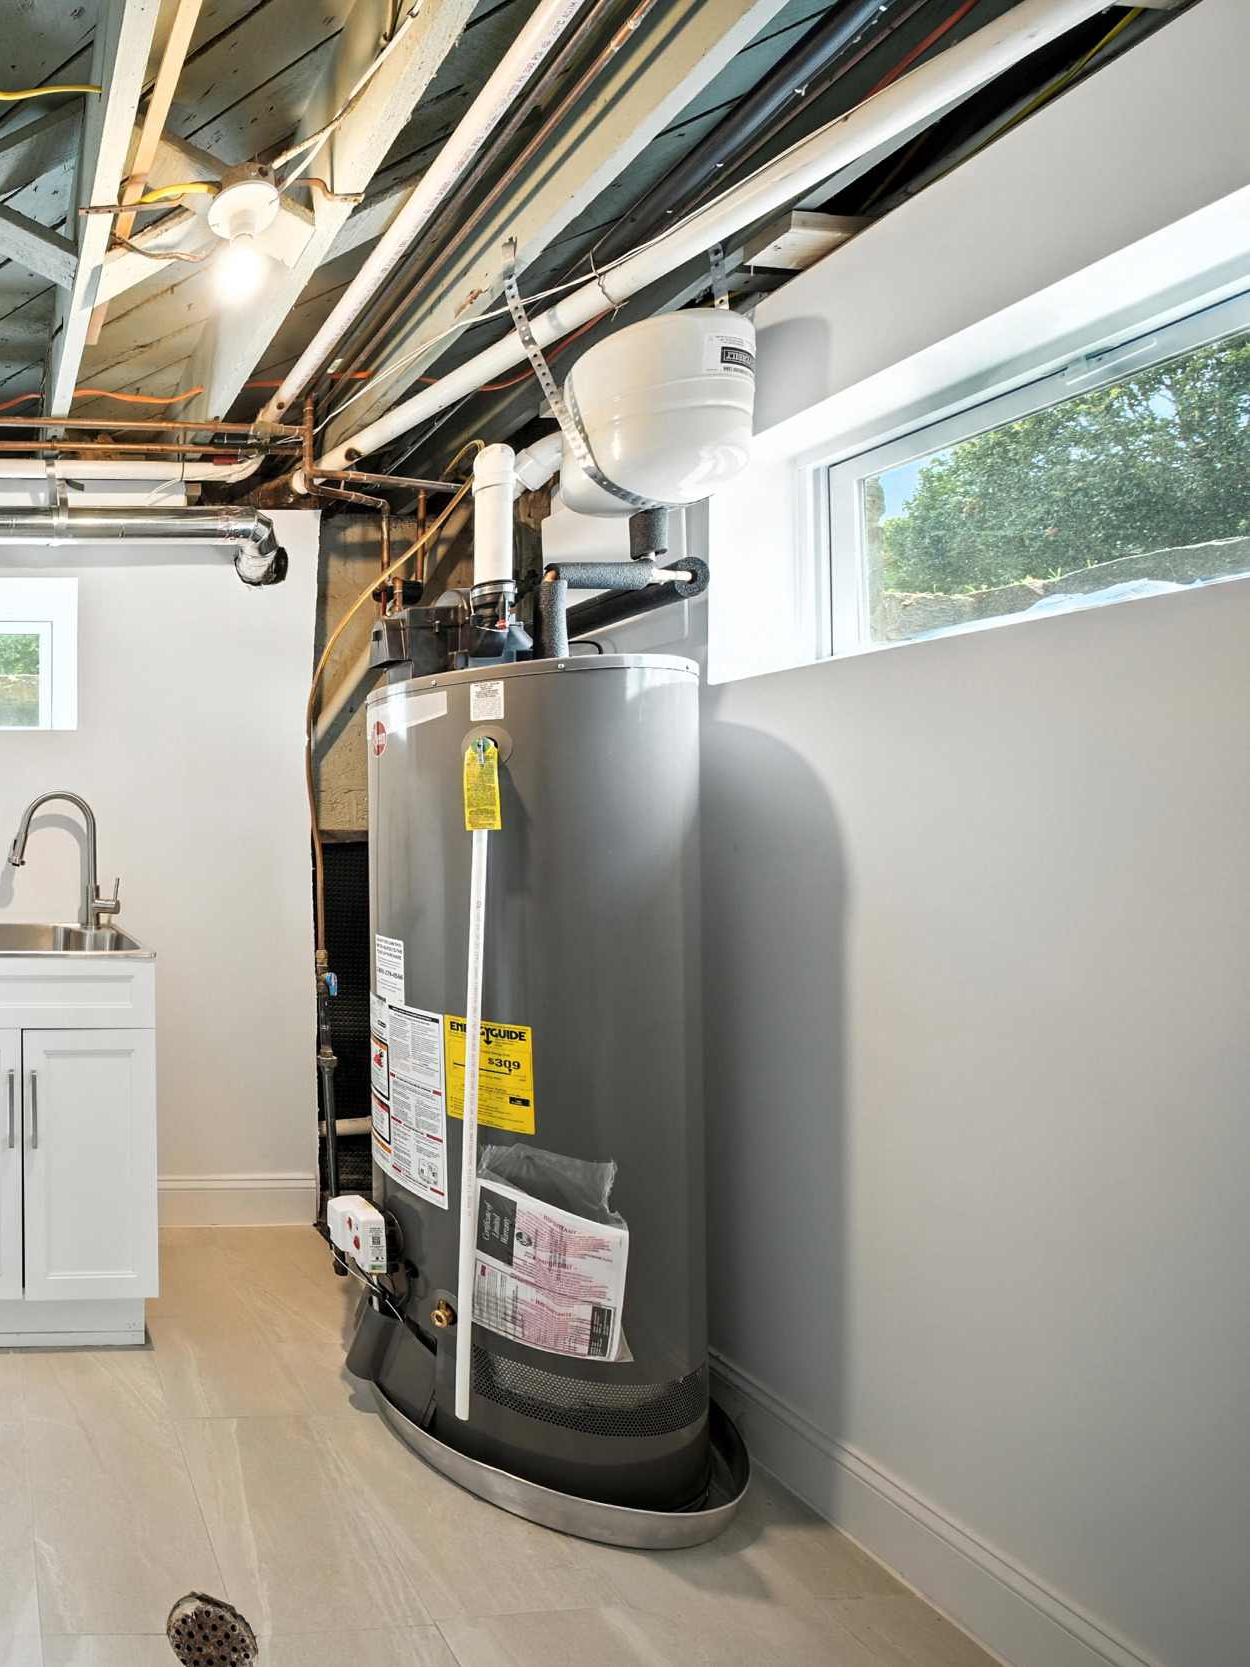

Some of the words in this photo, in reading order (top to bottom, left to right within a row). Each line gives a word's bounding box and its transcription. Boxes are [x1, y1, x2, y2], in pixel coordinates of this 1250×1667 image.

[562, 2, 576, 18] ASTM
[488, 1058, 520, 1070] $309
[482, 1210, 491, 1240] Certificate
[492, 1212, 500, 1238] Limited
[501, 1216, 511, 1244] Warranty
[543, 1214, 577, 1234] IMPORTANT
[536, 1258, 572, 1270] IMPORTANT
[536, 1300, 572, 1317] IMPORTANTE
